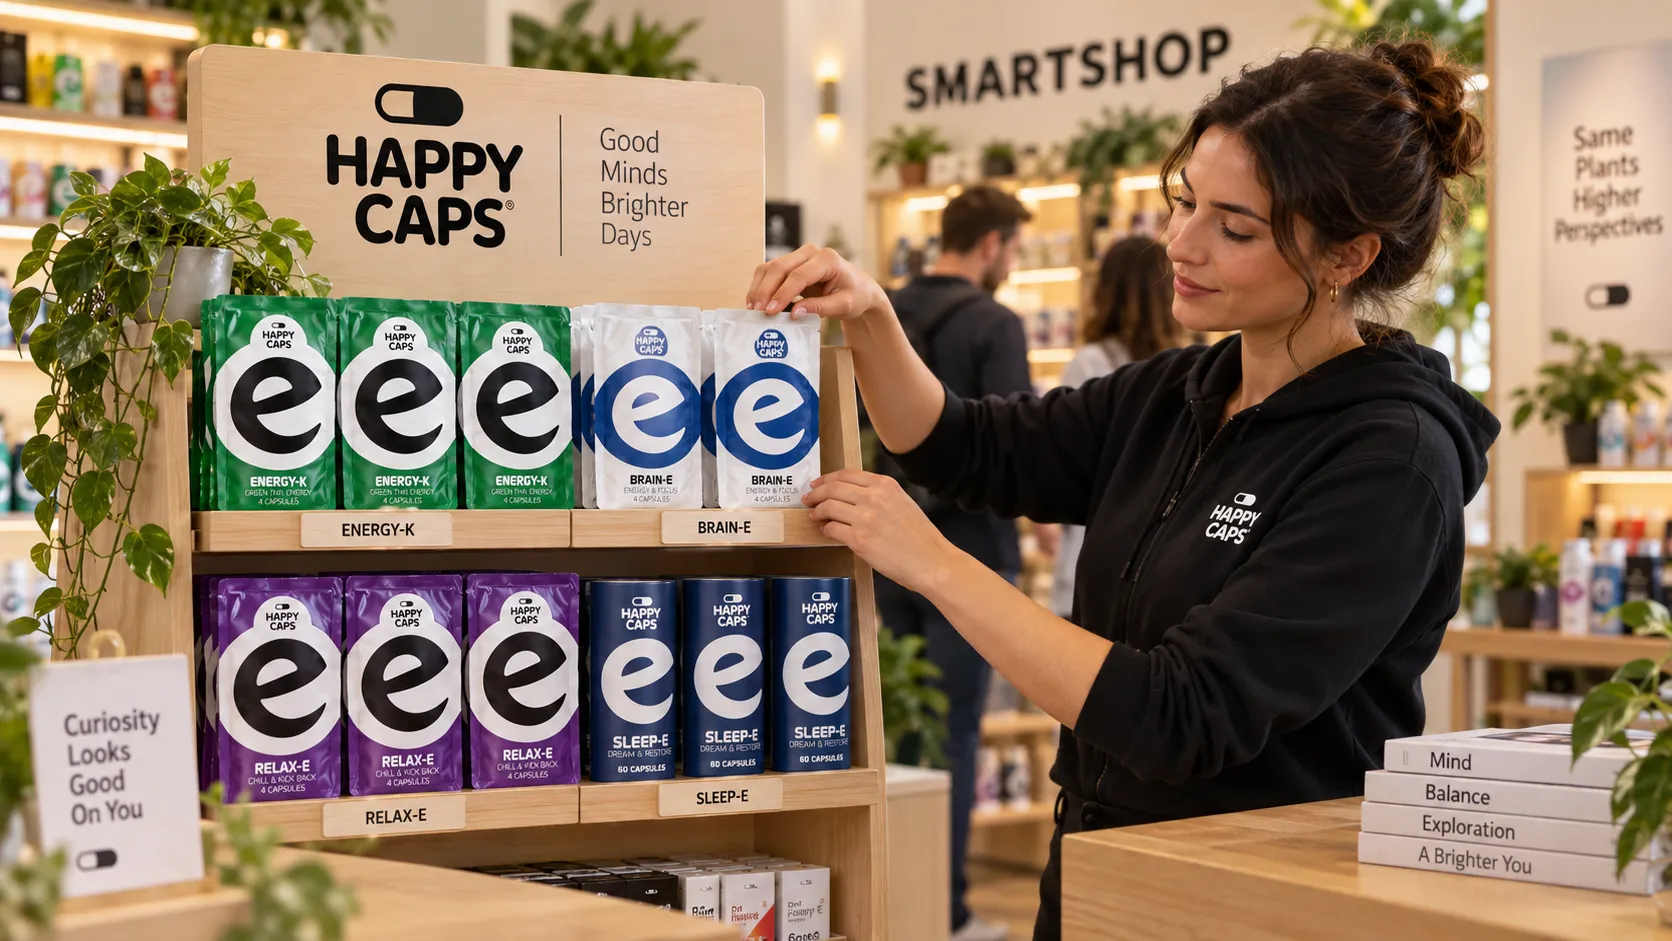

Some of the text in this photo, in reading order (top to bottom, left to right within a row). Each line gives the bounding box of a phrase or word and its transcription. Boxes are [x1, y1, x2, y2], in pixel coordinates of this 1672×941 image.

[904, 25, 1231, 111] SMARTSHOP
[600, 127, 660, 154] Good
[1573, 124, 1634, 150] Same
[326, 134, 523, 193] HAPPY
[1575, 153, 1640, 182] Plants
[600, 160, 668, 186] Minds
[1573, 184, 1642, 216] Higher
[601, 191, 689, 222] Brighter
[1554, 214, 1664, 246] Perspectives
[601, 222, 652, 252] Days
[262, 330, 295, 340] HAPPY
[384, 333, 416, 342] HAPPY
[503, 336, 533, 345] HAPPY
[266, 340, 292, 349] CAPS
[389, 342, 414, 351] CAPS
[635, 337, 665, 346] HAPPY
[757, 340, 785, 349] HAPPY
[507, 346, 530, 354] CAPS
[639, 345, 664, 354] CAPS
[759, 348, 784, 357] CAPS
[250, 476, 307, 487] ENERGY-K
[375, 476, 430, 487] ENERGY-K
[495, 475, 548, 486] ENERGY-K
[630, 475, 673, 485] BRAIN-E
[751, 475, 792, 485] BRAIN-E
[1209, 504, 1262, 528] HAPPY
[342, 523, 415, 537] ENERGY-K
[698, 521, 751, 534] BRAIN-E
[391, 609, 423, 618] HAPPY
[510, 606, 541, 616] HAPPY
[621, 607, 661, 619] HAPPY
[713, 604, 751, 616] HAPPY
[801, 602, 838, 614] HAPPY
[265, 612, 299, 621] HAPPY
[514, 616, 538, 625] CAPS
[717, 615, 748, 627] CAPS
[806, 613, 835, 625] CAPS
[270, 622, 296, 631] CAPS
[395, 618, 420, 628] CAPS
[625, 619, 658, 631] CAPS
[63, 708, 160, 737] Curiosity
[705, 728, 759, 743] SLEEP-E
[794, 724, 846, 739] SLEEP-E
[612, 733, 669, 749] SLEEP-E
[67, 740, 131, 767] Looks
[503, 747, 553, 761] RELAX-E
[811, 753, 844, 763] CAPSULES
[382, 753, 434, 768] RELAX-E
[722, 758, 756, 768] CAPSULES
[1430, 751, 1472, 771] Mind
[254, 760, 310, 775] RELAX-E
[630, 763, 666, 773] CAPSULES
[514, 770, 549, 779] CAPSULES
[69, 768, 125, 796] Good
[268, 784, 306, 793] CAPSULES
[1425, 783, 1490, 806] Balance
[696, 789, 749, 805] SLEEP-E
[71, 799, 143, 826] On You
[365, 808, 427, 825] RELAX-E
[1422, 814, 1515, 841] Exploration
[1418, 846, 1532, 875] A Brighter You
